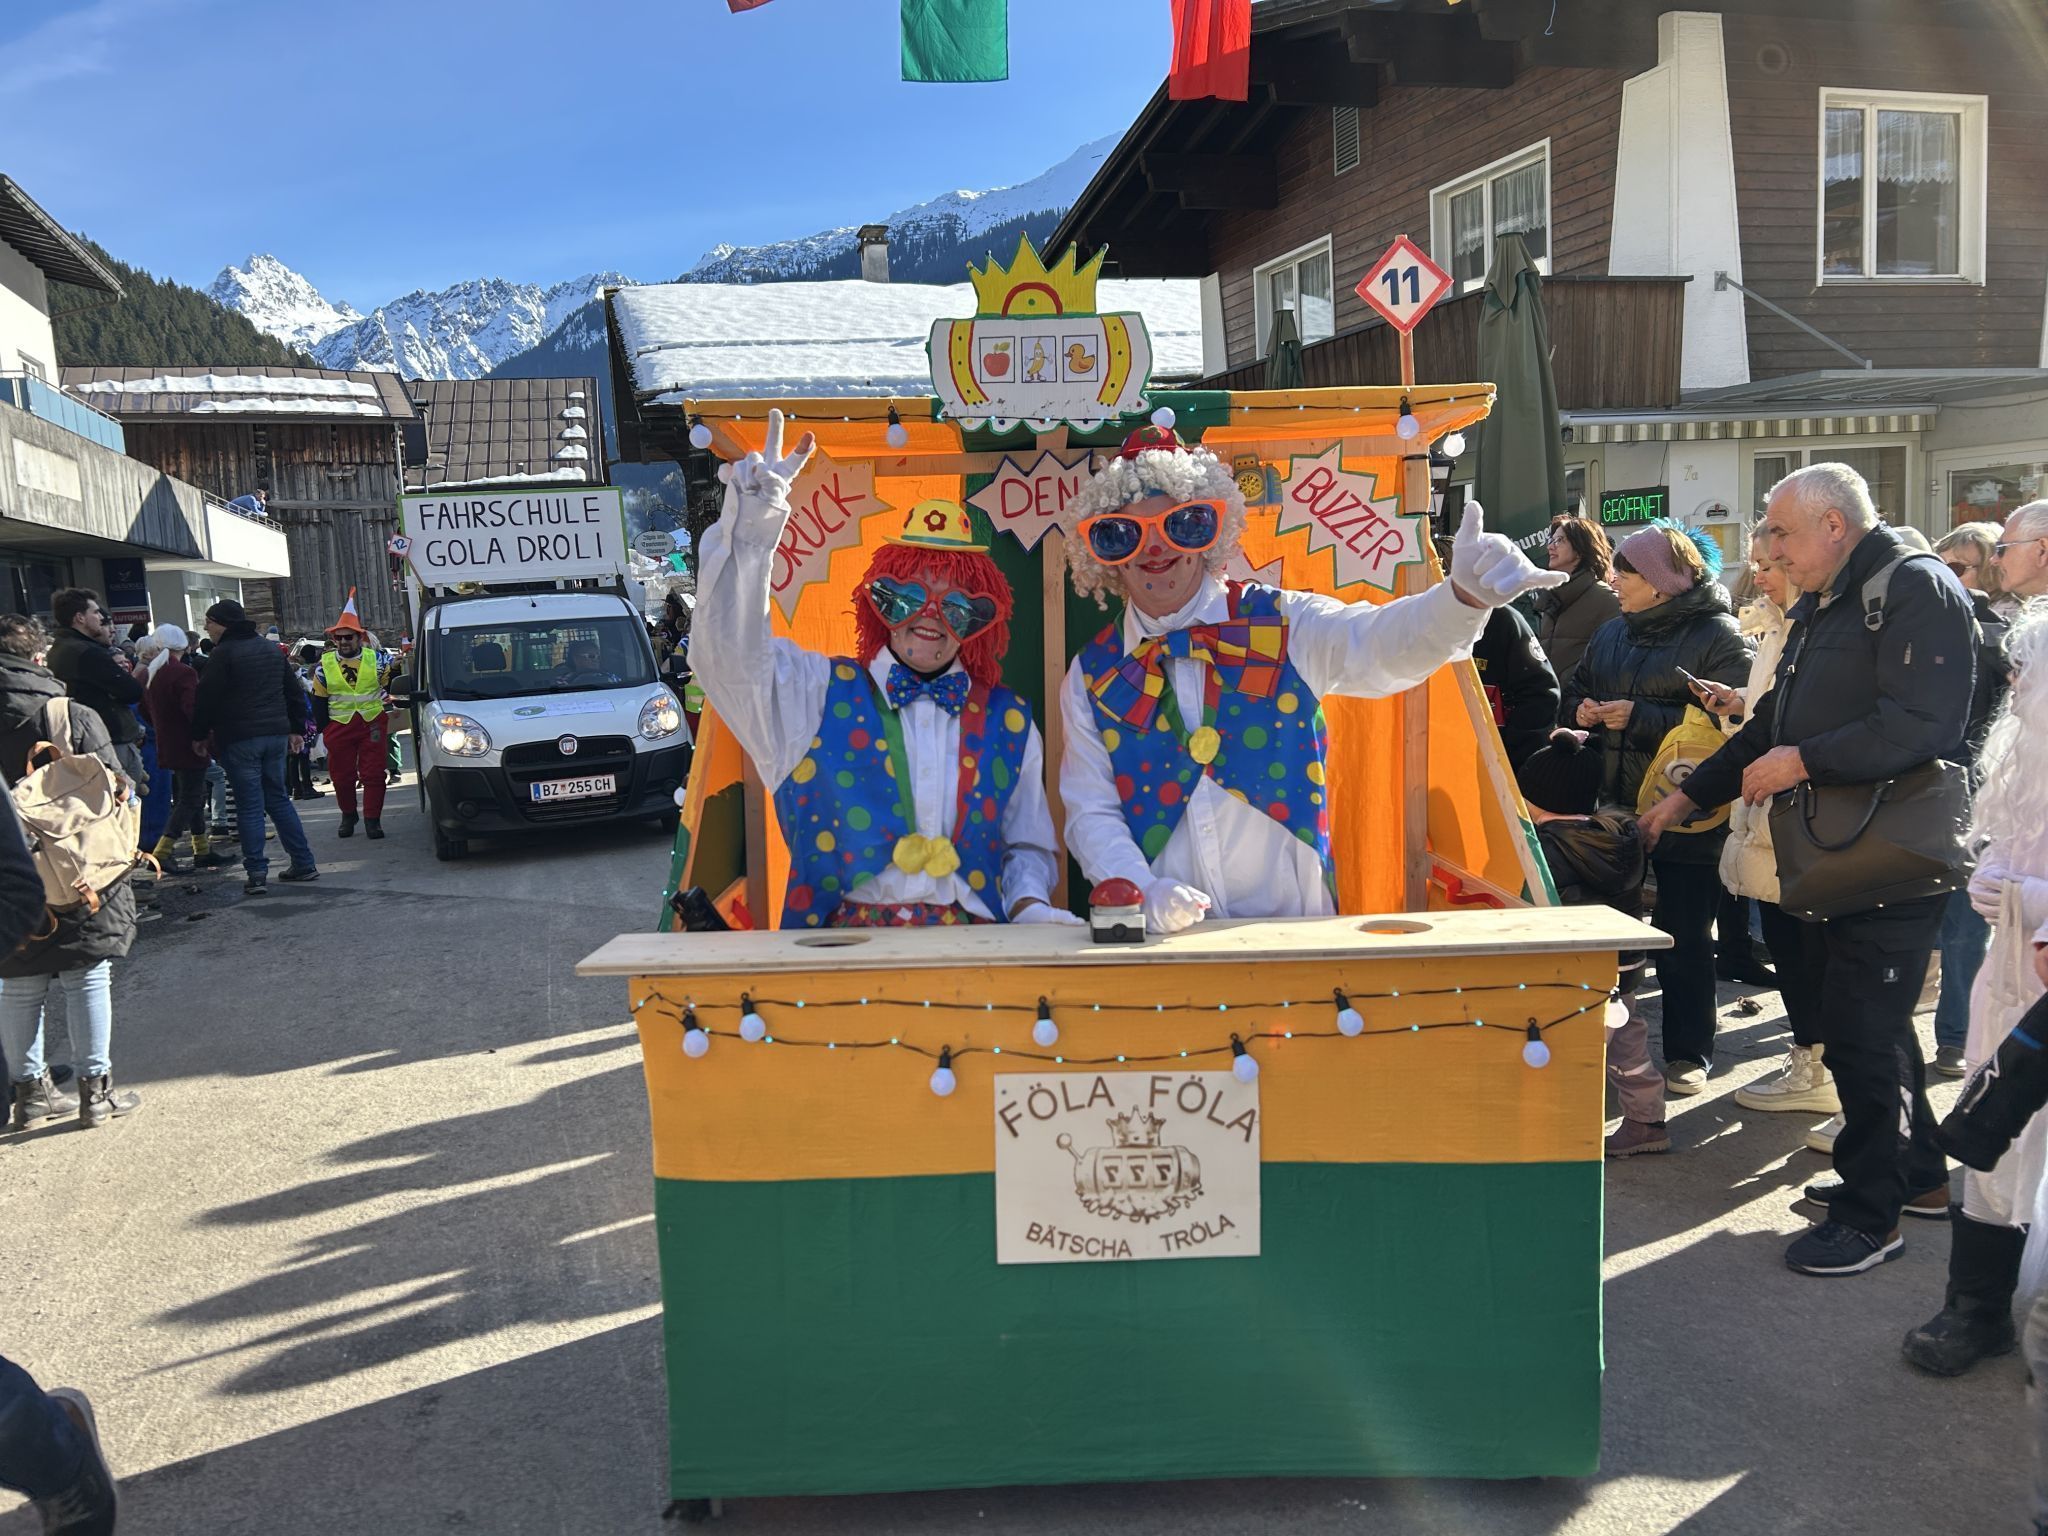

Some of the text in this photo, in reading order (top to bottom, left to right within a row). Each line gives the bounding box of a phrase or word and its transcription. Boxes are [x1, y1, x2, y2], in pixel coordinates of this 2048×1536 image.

[1382, 266, 1420, 306] 11
[1683, 464, 1699, 481] 7a
[419, 496, 601, 531] FAHRSCHULE
[1000, 475, 1079, 519] DEN
[1602, 493, 1664, 523] GEÖFFNET
[771, 472, 866, 592] DRÜCK
[1291, 466, 1404, 571] BUZZER
[392, 538, 408, 550] 12
[426, 532, 603, 567] GOLA DROLI
[543, 778, 611, 797] BZ 255 CH
[998, 1074, 1257, 1144] FÖLA FÖLA
[1025, 1213, 1236, 1258] BÄTSCHA TRÖLA
